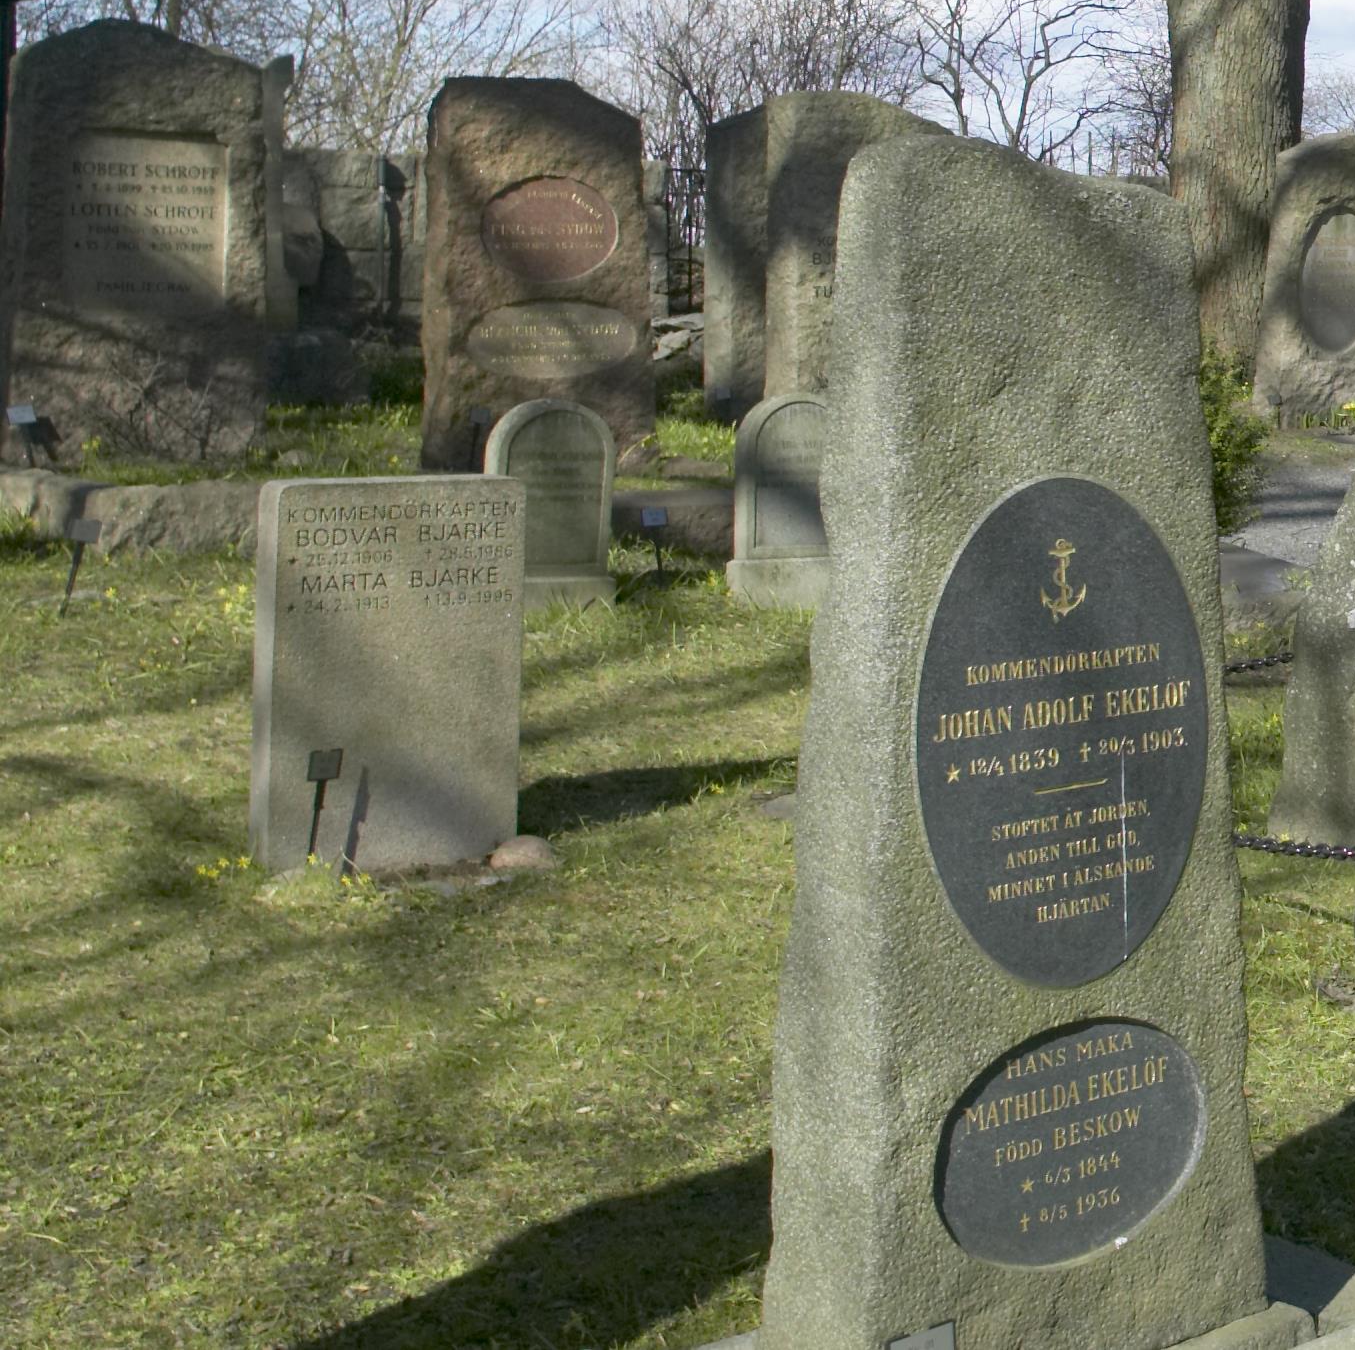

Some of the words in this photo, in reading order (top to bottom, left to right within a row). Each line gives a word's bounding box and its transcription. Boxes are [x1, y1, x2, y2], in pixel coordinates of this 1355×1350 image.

[72, 161, 138, 178] ROBERT
[144, 164, 220, 180] SCHROFF
[71, 202, 137, 219] LOTTEN
[144, 204, 217, 221] SCHROFF
[287, 500, 518, 524] KOMMENDÖRKAPTEN
[296, 526, 398, 548] BODVAR
[418, 521, 507, 543] BJARKE
[410, 566, 499, 589] BJARKE
[965, 642, 1161, 687] KOMMENDÖRKAPTEN
[933, 705, 1013, 744] JOHAN
[1021, 693, 1095, 731] ADOLF
[1104, 675, 1192, 718] EKELÖF
[1008, 747, 1061, 775] 1839
[991, 815, 1059, 842] STOFTET
[1064, 807, 1084, 829] ÅT
[1088, 799, 1151, 825] JORDEN,
[1005, 843, 1061, 870] ANDEN
[1066, 837, 1101, 858] TILL
[987, 874, 1057, 903] MINNET
[1062, 871, 1069, 889] I
[1073, 854, 1155, 887] ÄLSKANDE
[1006, 1047, 1066, 1080] HANS
[1076, 1031, 1134, 1062] MAKA
[964, 1081, 1081, 1135] MATHILDA
[1087, 1055, 1169, 1102] EKELÖF
[994, 1138, 1043, 1167] FÖDD
[1053, 1104, 1142, 1151] BESKOW
[1045, 1165, 1072, 1187] 6/3
[1078, 1150, 1121, 1179] 1844
[1039, 1203, 1068, 1225] 8/5
[1076, 1185, 1121, 1216] 1936
